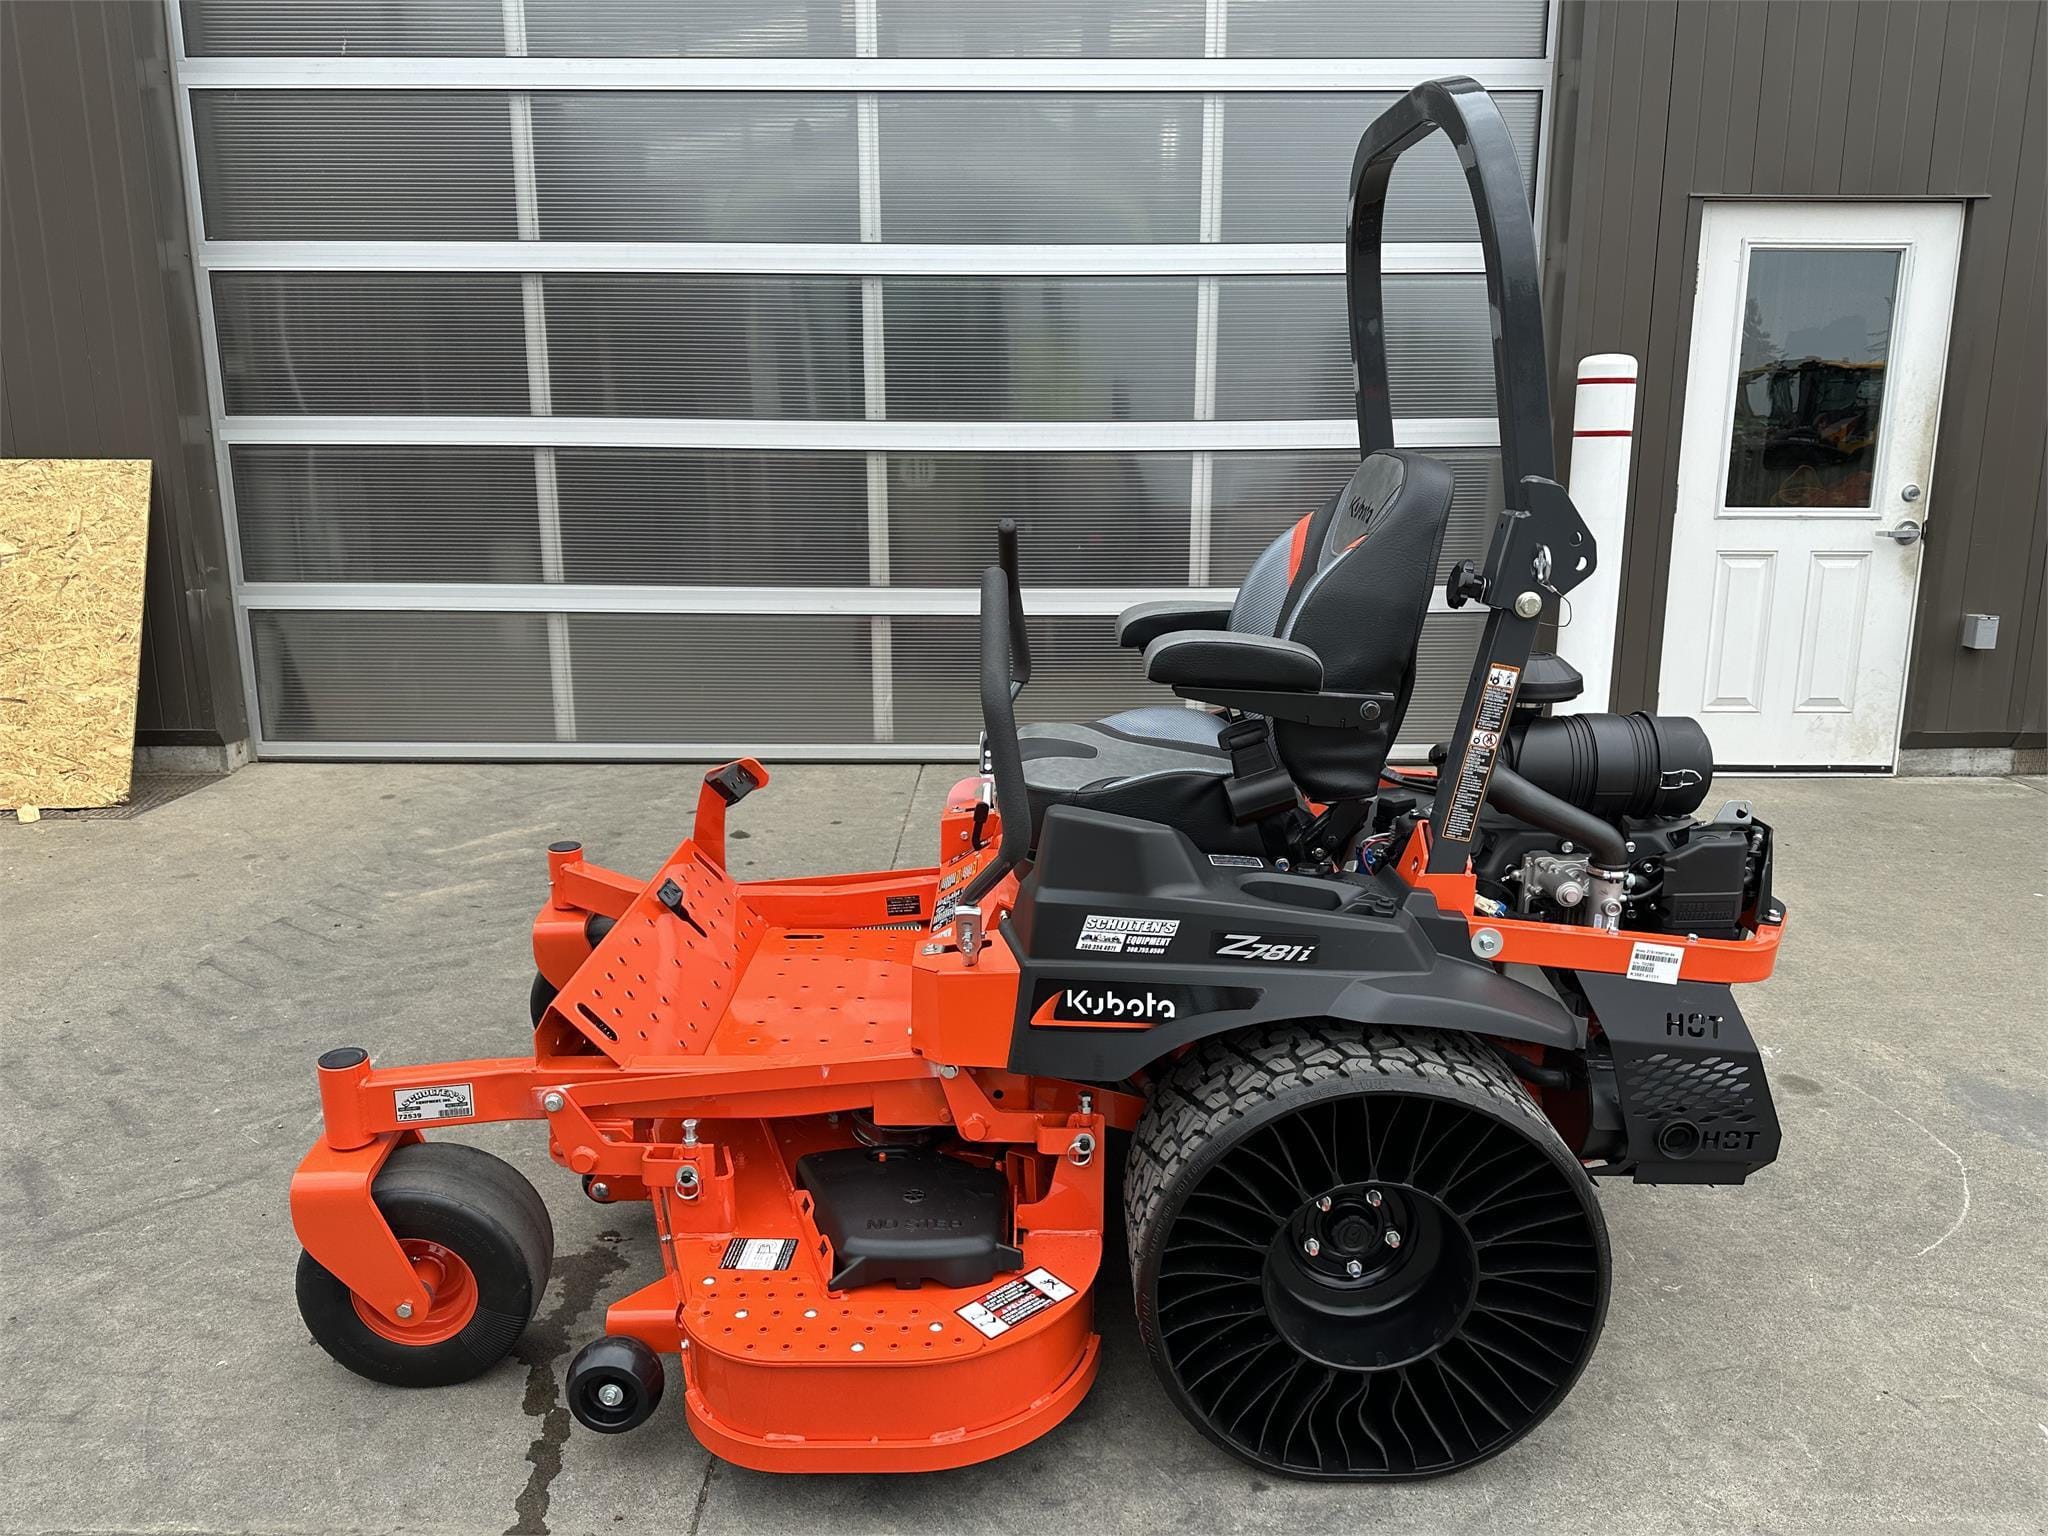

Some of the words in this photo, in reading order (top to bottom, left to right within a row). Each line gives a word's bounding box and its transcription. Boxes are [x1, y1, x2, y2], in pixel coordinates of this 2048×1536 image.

[1086, 917, 1176, 934] SCHOLTEN'S
[1126, 935, 1172, 946] EQUIPMENT
[1215, 934, 1316, 962] Z781i
[1066, 989, 1176, 1018] Kubota
[1666, 1012, 1724, 1039] HOT
[401, 1088, 466, 1108] SCHOLTEN'S
[1701, 1130, 1760, 1152] HOT
[866, 1218, 898, 1230] NO
